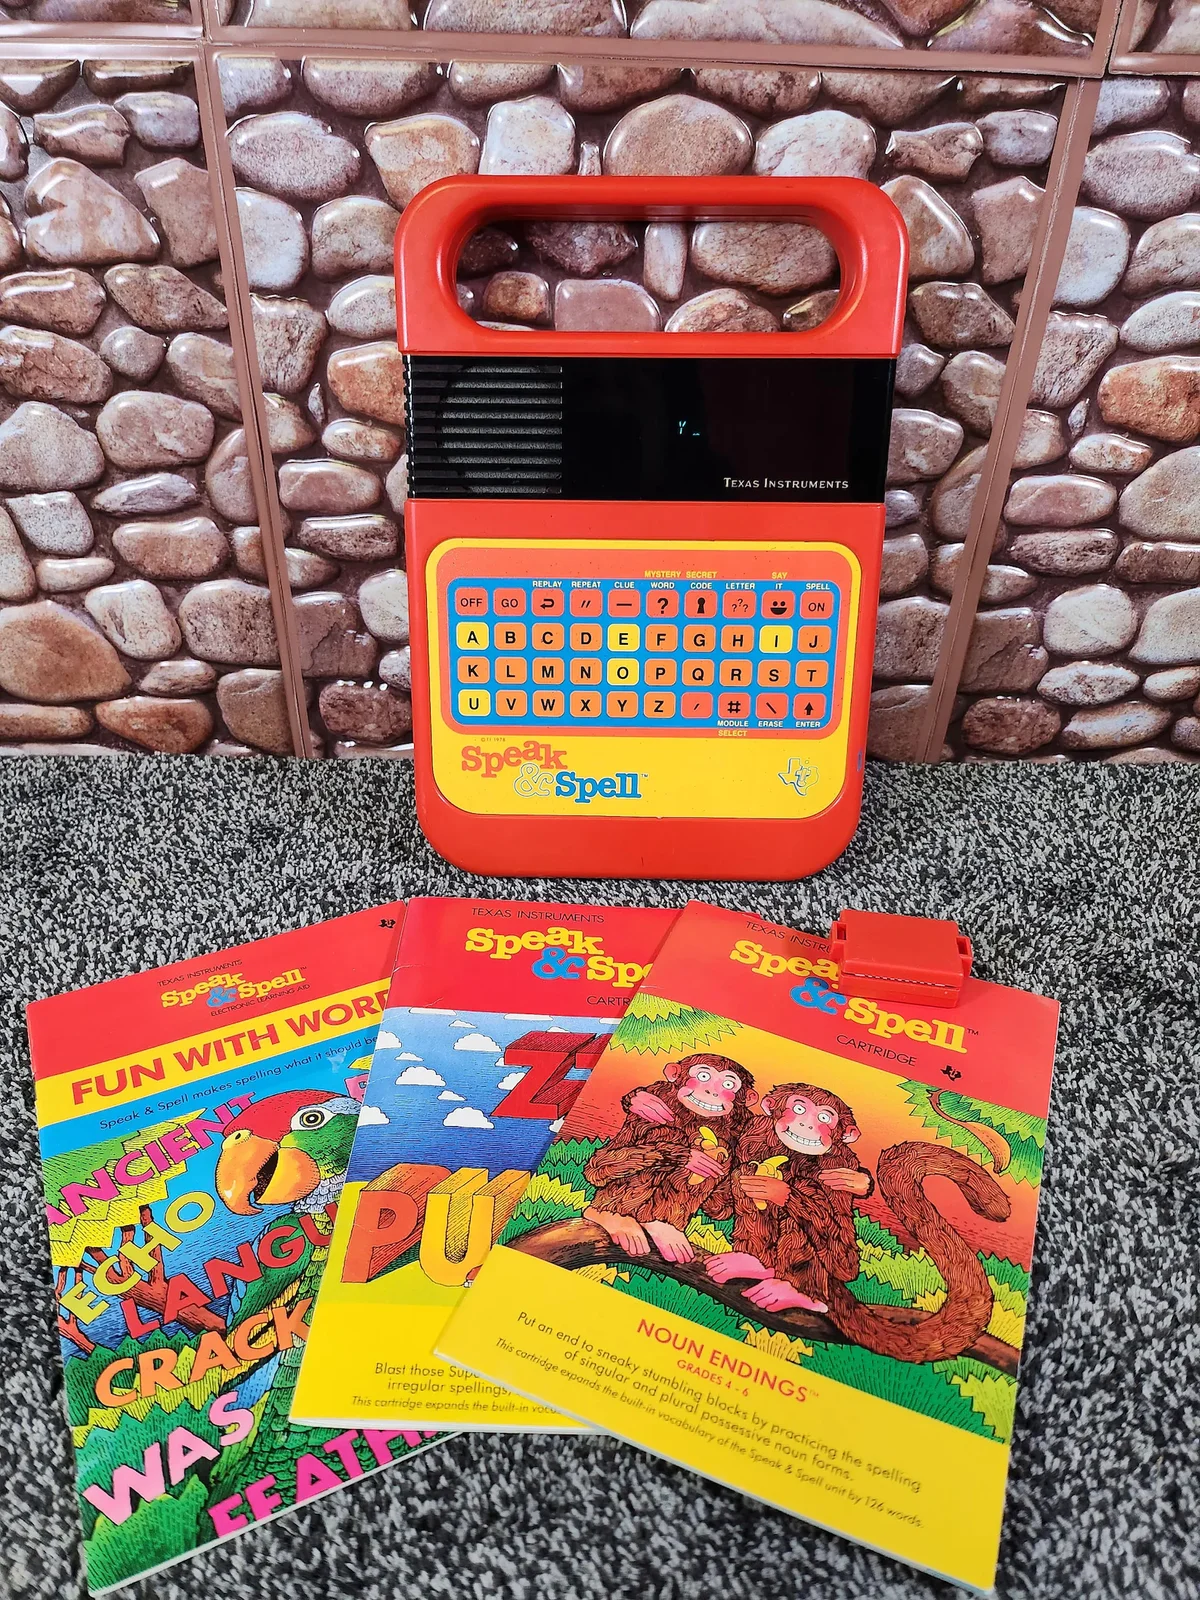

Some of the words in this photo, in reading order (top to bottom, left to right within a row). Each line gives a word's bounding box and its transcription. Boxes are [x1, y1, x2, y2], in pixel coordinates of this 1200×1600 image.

[723, 477, 760, 489] TEXAS
[764, 477, 849, 490] INSTRUMENTS
[644, 570, 682, 579] MYSTERY
[686, 571, 717, 579] SECRET
[771, 571, 788, 580] SAY
[532, 580, 562, 588] REPLAY
[571, 581, 601, 589] REPEAT
[614, 581, 635, 589] CLUE
[650, 581, 675, 589] WORD
[690, 582, 712, 590] CODE
[725, 582, 755, 590] LETTER
[775, 582, 783, 590] IT
[805, 583, 830, 591] SPELL
[460, 597, 483, 608] OFF
[501, 598, 519, 608] GO
[808, 602, 825, 612] ON
[467, 631, 478, 644] A
[505, 631, 516, 644] B
[542, 631, 554, 645] C
[580, 632, 592, 645] D
[618, 632, 629, 645] E
[656, 633, 667, 646] F
[693, 633, 706, 647] G
[732, 634, 744, 647] H
[808, 635, 818, 648] J
[468, 664, 478, 677] K
[506, 665, 516, 678] L
[542, 666, 554, 678] M
[580, 666, 591, 679] N
[616, 666, 629, 680] O
[655, 667, 666, 680] P
[692, 667, 704, 681] Q
[730, 668, 742, 681] R
[768, 668, 780, 682] S
[806, 670, 817, 682] T
[469, 698, 480, 710] U
[506, 698, 516, 711] V
[540, 698, 556, 711] W
[580, 699, 591, 712] X
[617, 700, 628, 712] Y
[654, 700, 664, 713] Z
[718, 729, 748, 737] SELECT
[758, 720, 784, 728] ERASE
[461, 740, 568, 778] Speak
[514, 762, 555, 798] &
[555, 771, 642, 804] Spell
[471, 907, 512, 919] TEXAS
[516, 909, 605, 924] INSTRUMENTS
[746, 921, 786, 940] TEXAS
[465, 926, 604, 960] Speak
[532, 947, 586, 981] &
[730, 940, 839, 988] Spea
[157, 975, 185, 988] TEXAS
[187, 959, 243, 979] INSTRUMENTS
[161, 972, 246, 1008] Speak
[206, 986, 238, 1008] &
[238, 968, 306, 999] Spell
[210, 1000, 256, 1017] ELECTRONIC
[257, 989, 295, 1004] LEARNING
[297, 983, 310, 992] AID
[789, 976, 847, 1015] &
[844, 996, 968, 1054] Spell
[836, 1034, 917, 1067] CARTRIDGE
[71, 1058, 165, 1106] FUN
[173, 1023, 281, 1072] WITH
[99, 1114, 140, 1130] Speak
[144, 1106, 154, 1116] &
[158, 1093, 189, 1117] Spell
[192, 1081, 232, 1100] makes
[235, 1066, 282, 1088] spelling
[284, 1055, 313, 1071] what
[314, 1052, 324, 1062] it
[325, 1039, 362, 1058] should
[60, 1191, 216, 1325] ECHO
[120, 1201, 338, 1339] LANGU
[95, 1297, 314, 1408] CRACK
[636, 1318, 705, 1359] NOUN
[708, 1349, 808, 1403] ENDINGS
[375, 1362, 406, 1375] Blast
[410, 1364, 445, 1377] those
[449, 1366, 480, 1380] Sup
[676, 1358, 722, 1386] GRADES
[725, 1380, 732, 1390] 4
[742, 1388, 749, 1397] 6
[388, 1378, 446, 1395] irregular
[352, 1396, 372, 1407] This
[374, 1396, 422, 1410] cartridge
[426, 1400, 470, 1412] expands
[472, 1401, 489, 1412] the
[491, 1402, 529, 1413] built-in
[518, 1311, 536, 1328] Put
[538, 1322, 553, 1335] an
[556, 1331, 581, 1346] end
[582, 1339, 594, 1353] to
[596, 1348, 640, 1374] sneaky
[642, 1367, 703, 1403] stumbling
[706, 1392, 748, 1420] blocks
[752, 1412, 768, 1430] by
[770, 1424, 838, 1460] practicing
[841, 1450, 862, 1468] the
[866, 1462, 922, 1494] spelling
[564, 1350, 580, 1361] of
[580, 1356, 630, 1384] singular
[632, 1380, 658, 1397] and
[660, 1391, 700, 1414] plural
[701, 1411, 771, 1446] possessive
[774, 1441, 808, 1462] noun
[496, 1338, 514, 1353] This
[516, 1348, 559, 1373] cartridge
[560, 1368, 600, 1391] expands
[602, 1384, 619, 1399] the
[620, 1394, 656, 1415] built-in
[658, 1412, 716, 1442] vocabulary
[716, 1438, 729, 1446] of
[730, 1440, 747, 1454] the
[750, 1448, 783, 1470] Speak
[795, 1468, 824, 1488] Spell
[824, 1482, 847, 1498] unit
[848, 1490, 862, 1505] by
[864, 1496, 884, 1512] 126
[81, 1390, 255, 1526] WAS
[207, 1429, 439, 1538] FEATH
